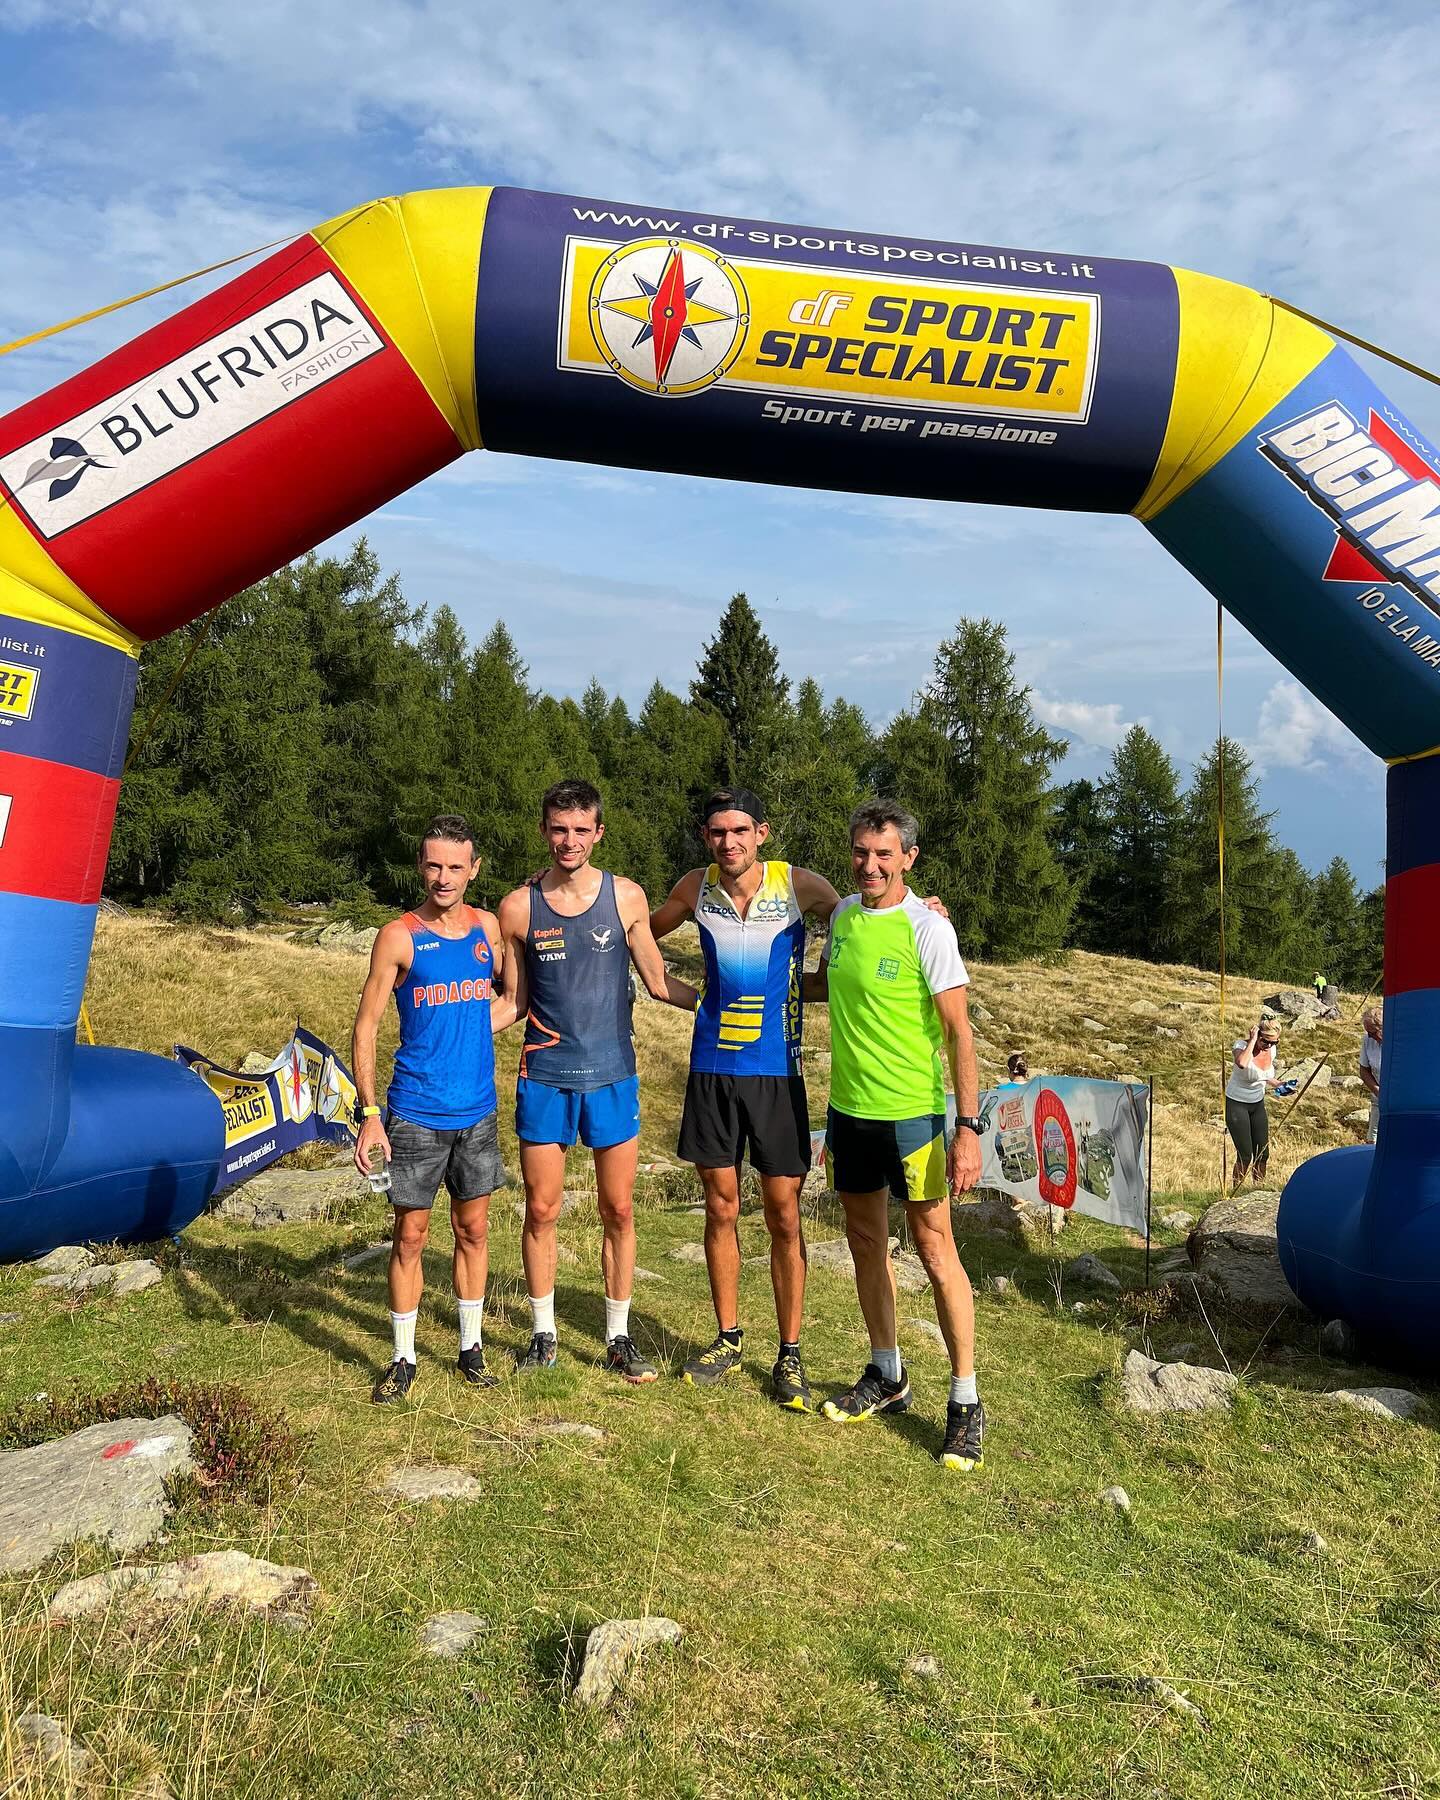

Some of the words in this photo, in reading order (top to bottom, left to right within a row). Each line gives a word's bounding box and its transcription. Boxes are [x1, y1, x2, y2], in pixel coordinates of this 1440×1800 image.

[573, 207, 1096, 279] www.df-sportspecialist.it
[864, 295, 1076, 350] SPORT
[100, 298, 354, 456] BLUFRIDA
[281, 333, 372, 392] FASHION
[755, 330, 1070, 394] SPECIALIST
[761, 400, 856, 426] Sport
[860, 413, 915, 433] per
[919, 420, 1058, 445] passione
[1356, 586, 1386, 609] IO
[1375, 603, 1401, 623] E
[1388, 615, 1420, 642] LA
[0, 636, 46, 657] list.it
[538, 952, 567, 962] VAM
[413, 978, 492, 1008] PIDAGGI
